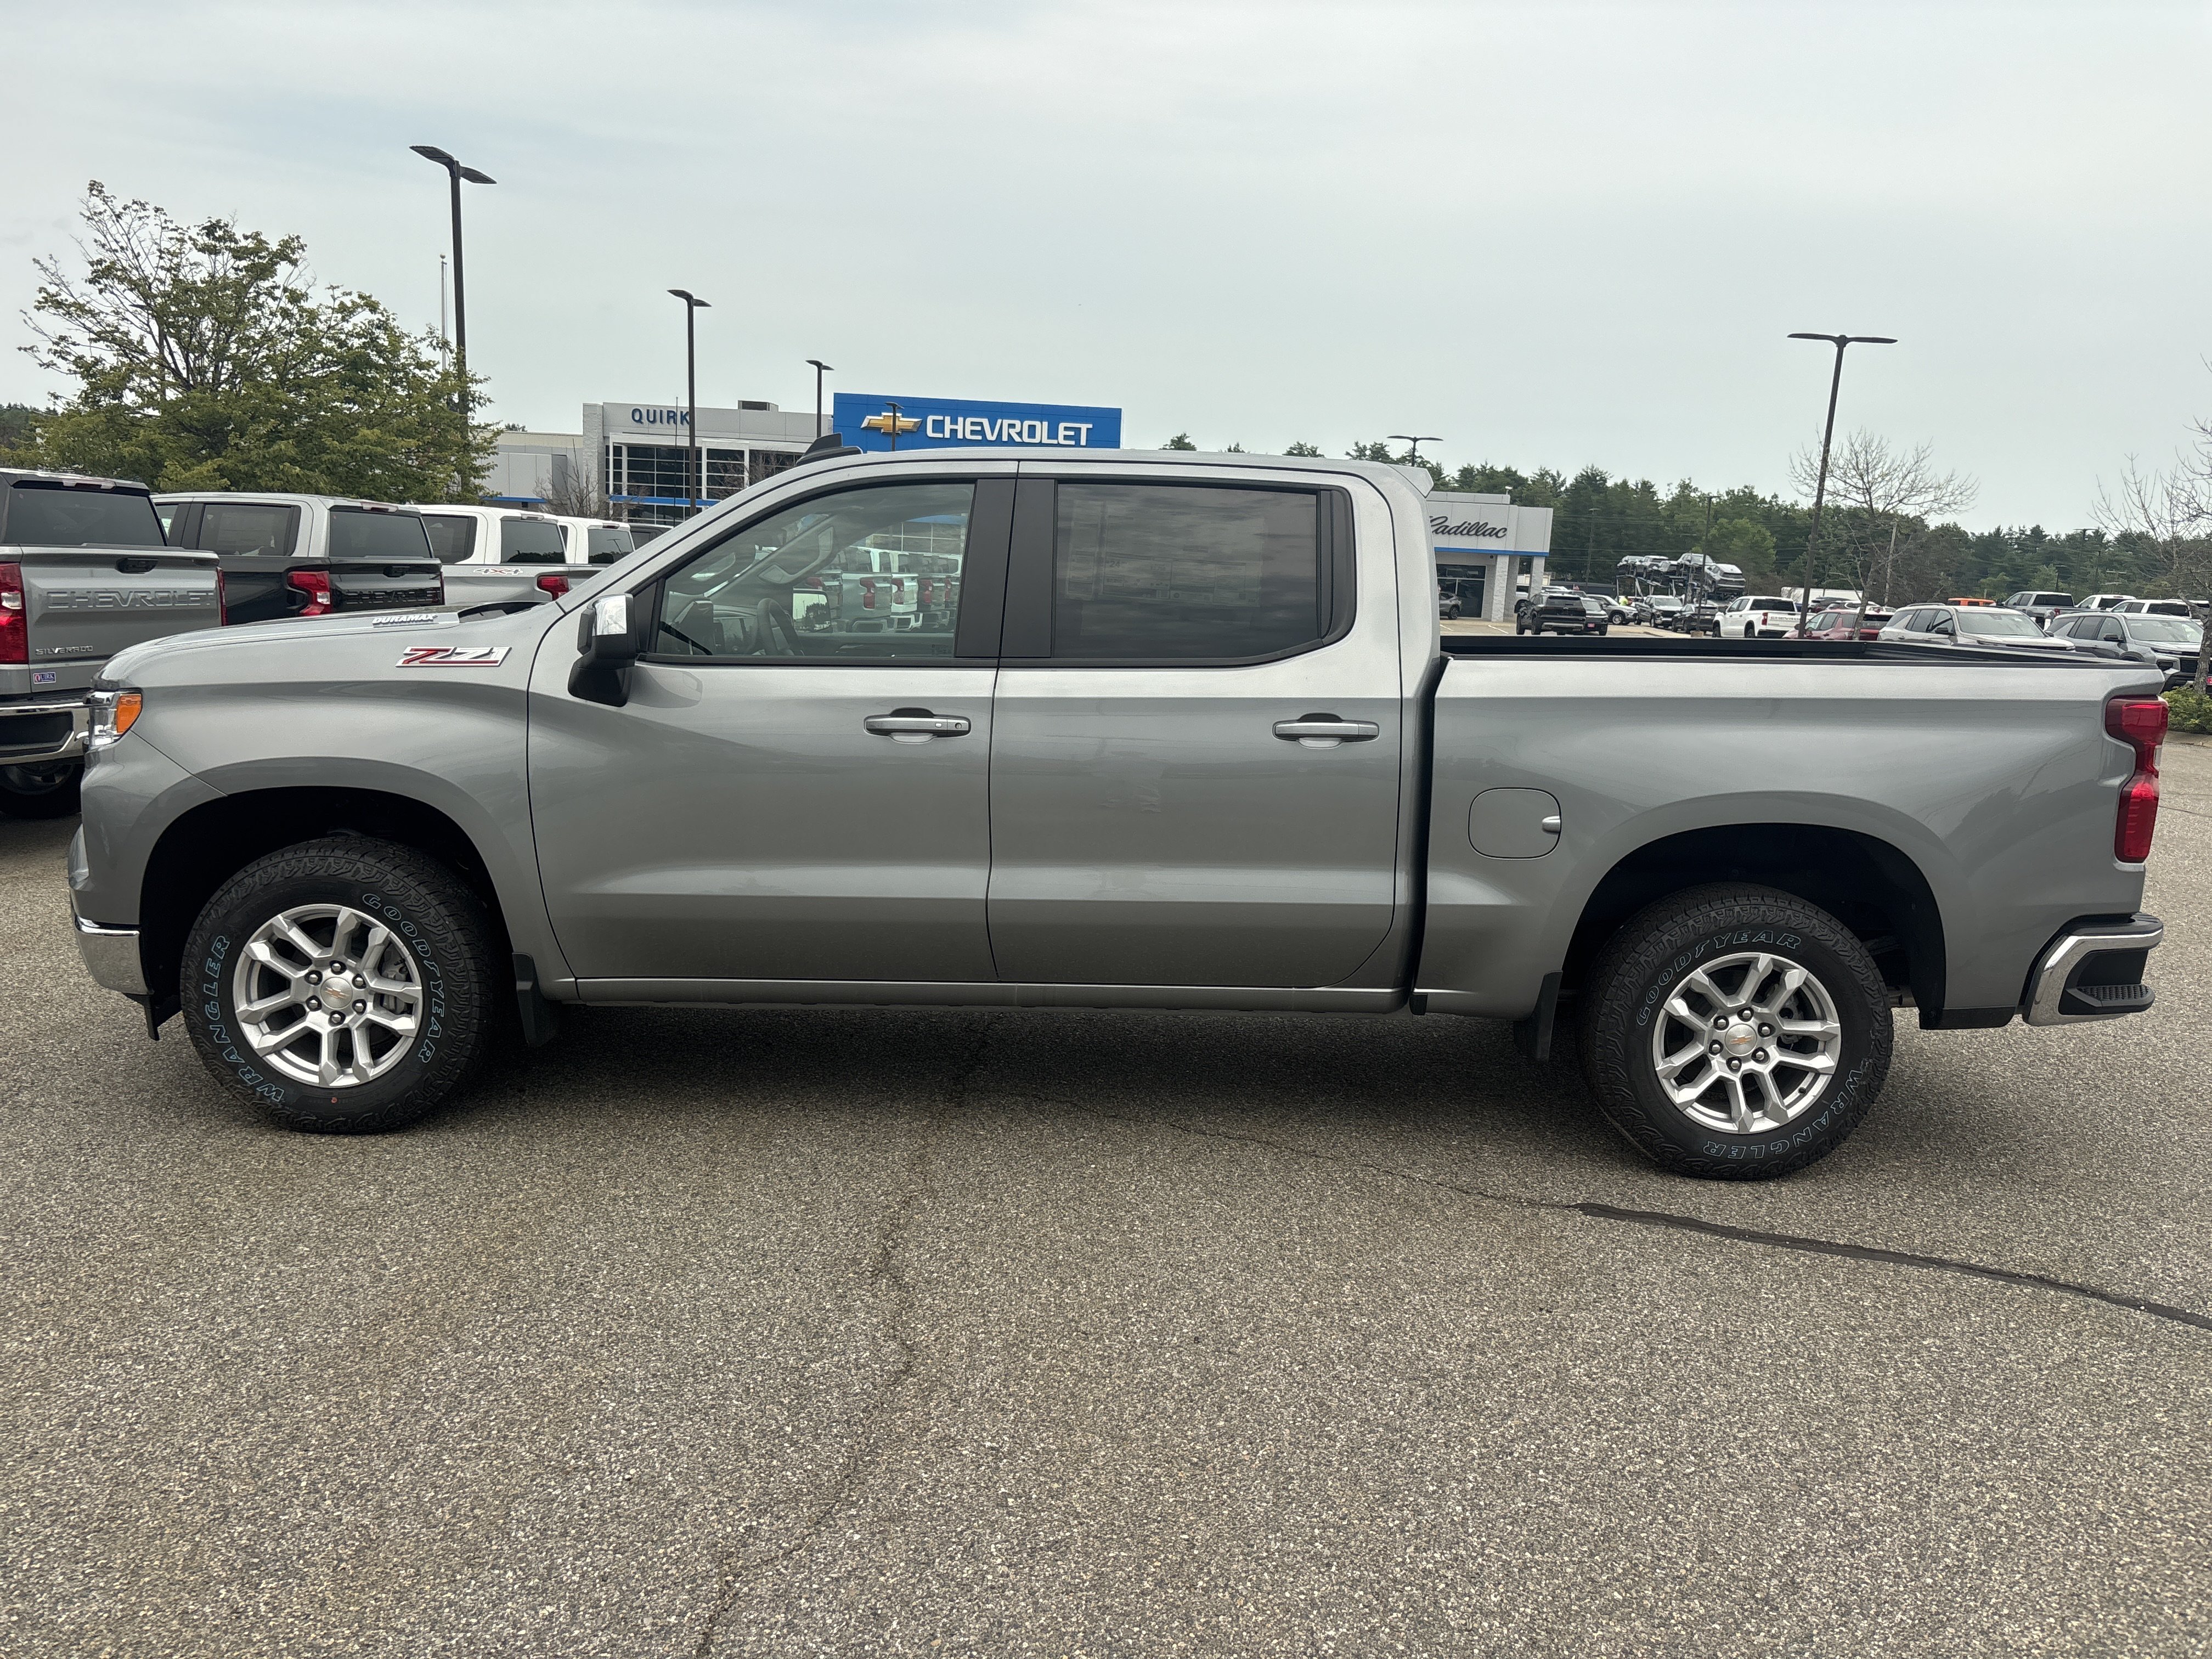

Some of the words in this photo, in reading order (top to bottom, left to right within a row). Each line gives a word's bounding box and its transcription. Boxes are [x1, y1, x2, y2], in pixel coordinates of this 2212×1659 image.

[631, 408, 690, 425] QUIRK
[926, 415, 1093, 446] CHEVROLET
[1429, 516, 1508, 538] Cadillac
[46, 591, 215, 609] CHEVROLET
[373, 614, 437, 625] DURAMAX
[35, 645, 93, 655] SILVERADO
[395, 646, 512, 668] Z71
[35, 674, 54, 682] QUIRK
[362, 893, 446, 1064] GOODYEAR
[1635, 929, 1802, 1026] GOODYEAR
[202, 934, 285, 1102] WRANGLER
[1702, 1068, 1864, 1160] WRANGLER
